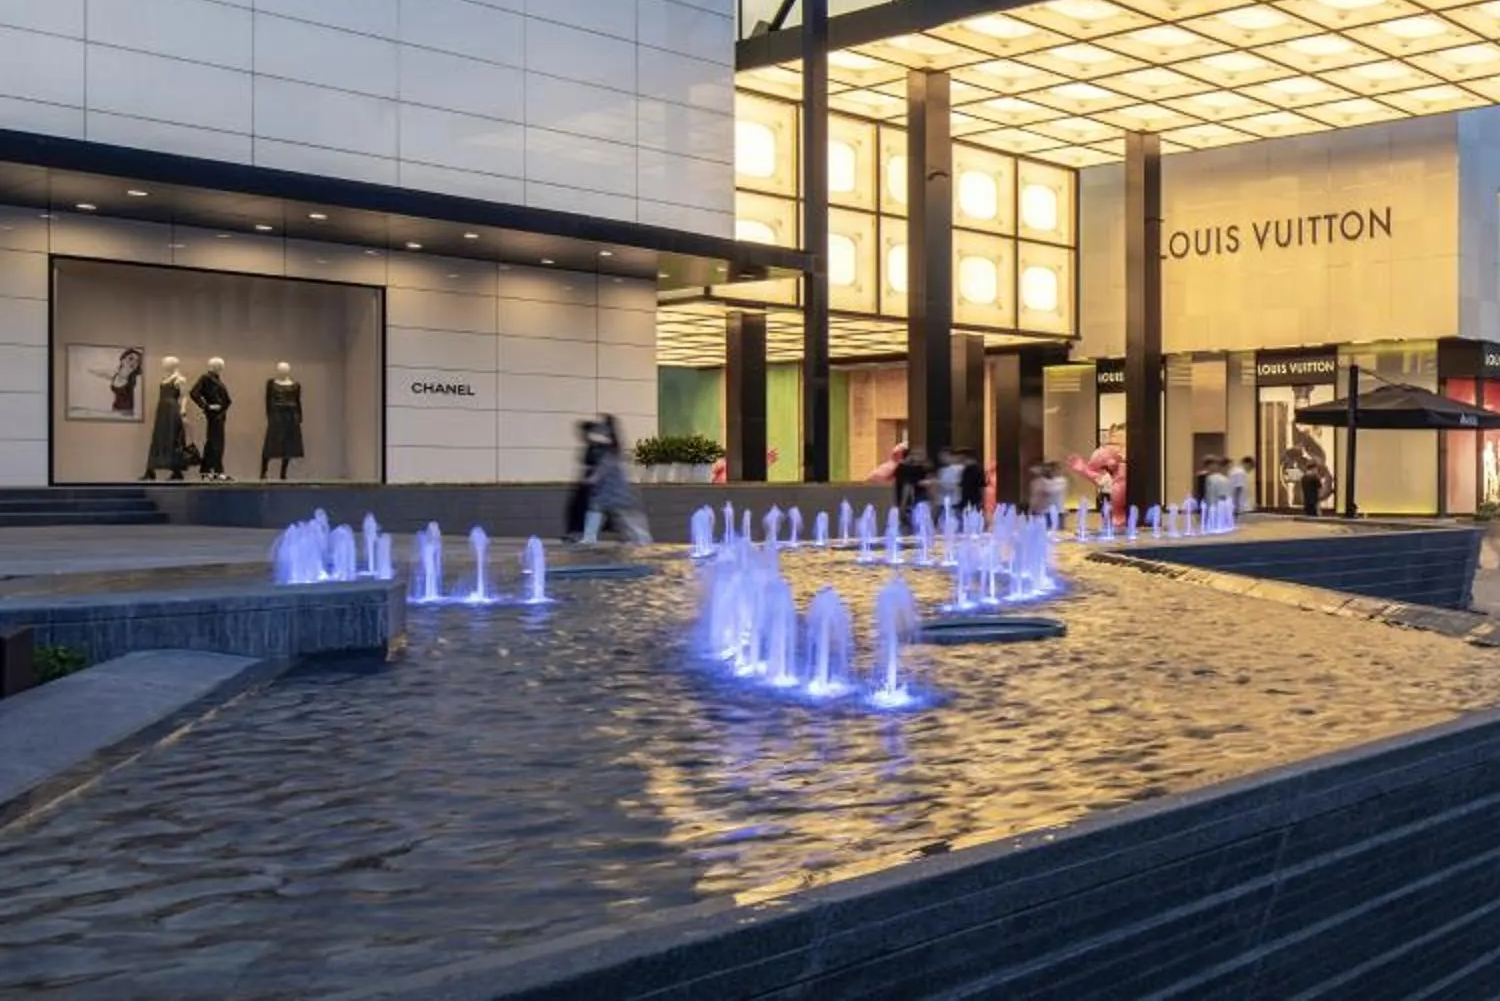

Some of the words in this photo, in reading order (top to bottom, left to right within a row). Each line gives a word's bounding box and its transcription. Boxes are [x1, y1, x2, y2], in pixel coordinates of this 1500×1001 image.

[1252, 206, 1393, 251] VUITTON
[1257, 363, 1287, 376] LOUIS
[411, 381, 475, 396] CHANEL
